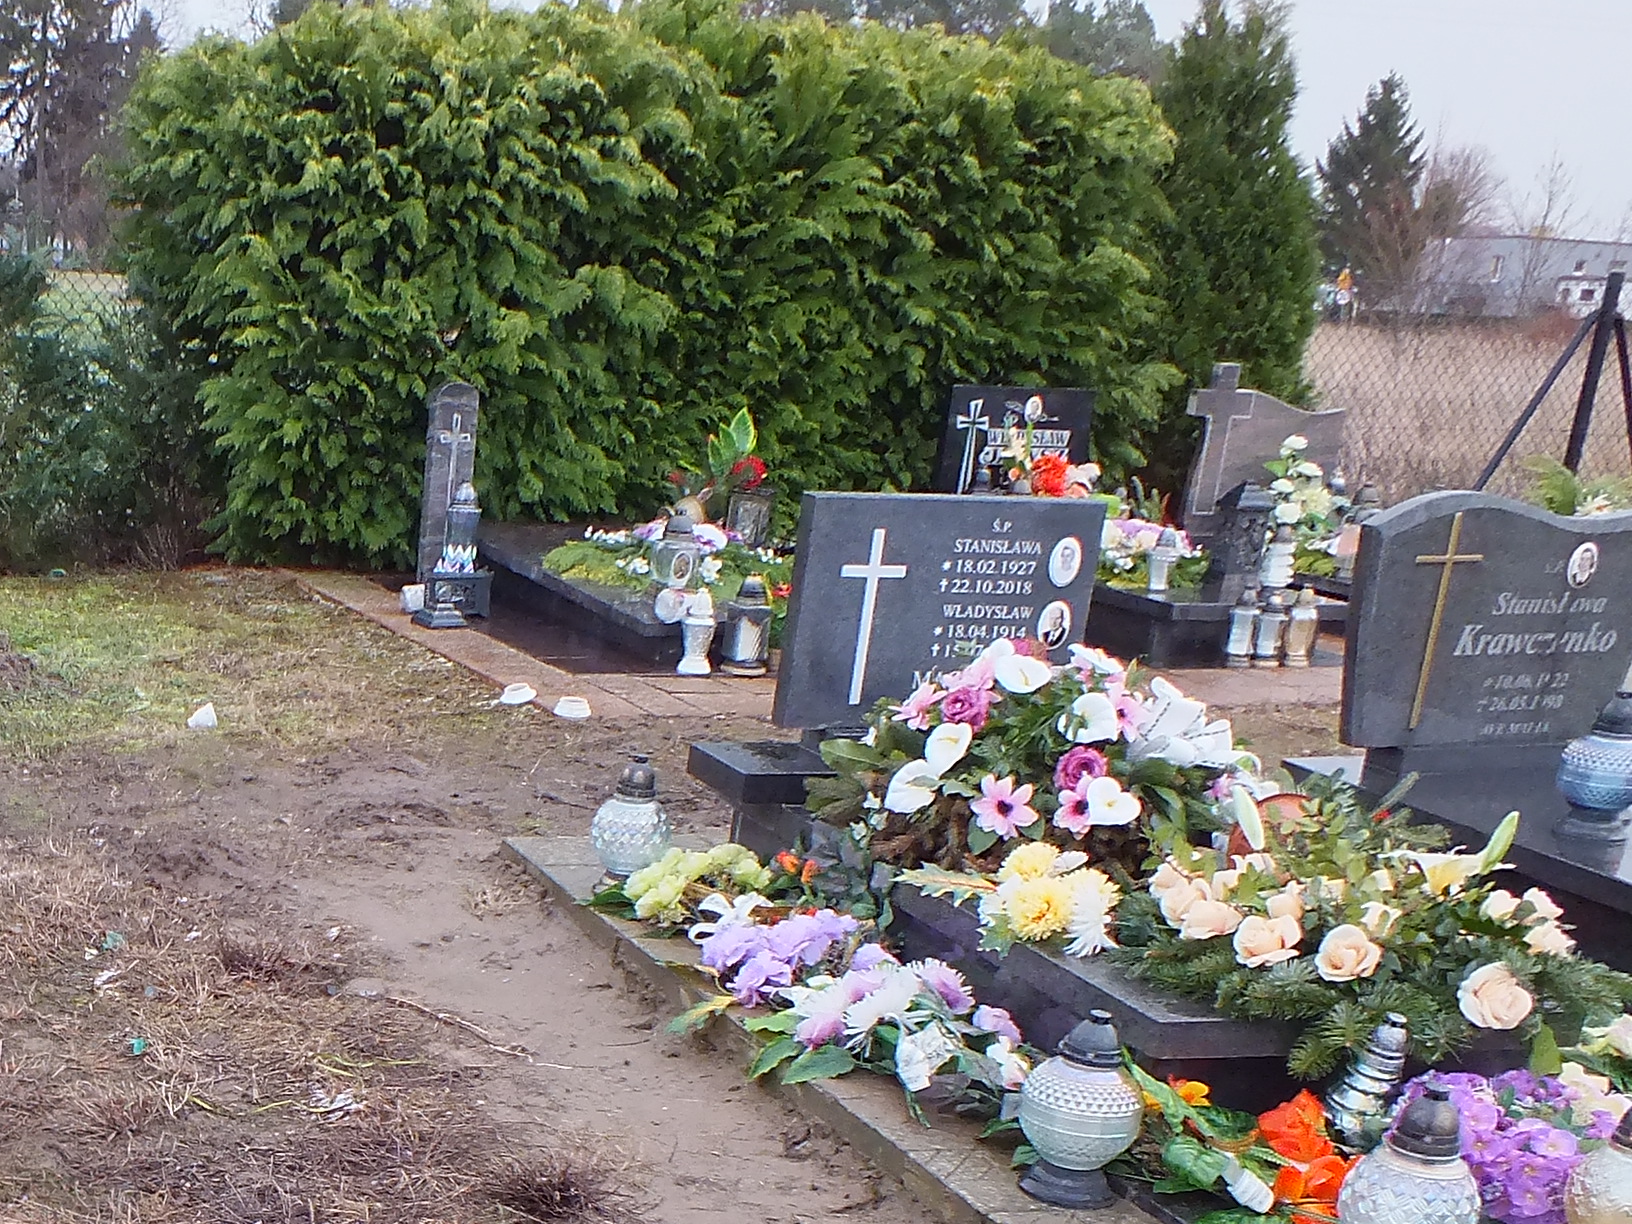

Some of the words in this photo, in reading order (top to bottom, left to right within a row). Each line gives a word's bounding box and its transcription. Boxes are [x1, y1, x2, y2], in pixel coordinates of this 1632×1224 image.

[954, 538, 1042, 555] STANISŁAWA
[955, 560, 1036, 576] 18.02.1927
[951, 579, 1033, 595] 22.10.2018
[943, 604, 1034, 619] WŁADYSŁAW
[947, 624, 1026, 639] 18.04.1914
